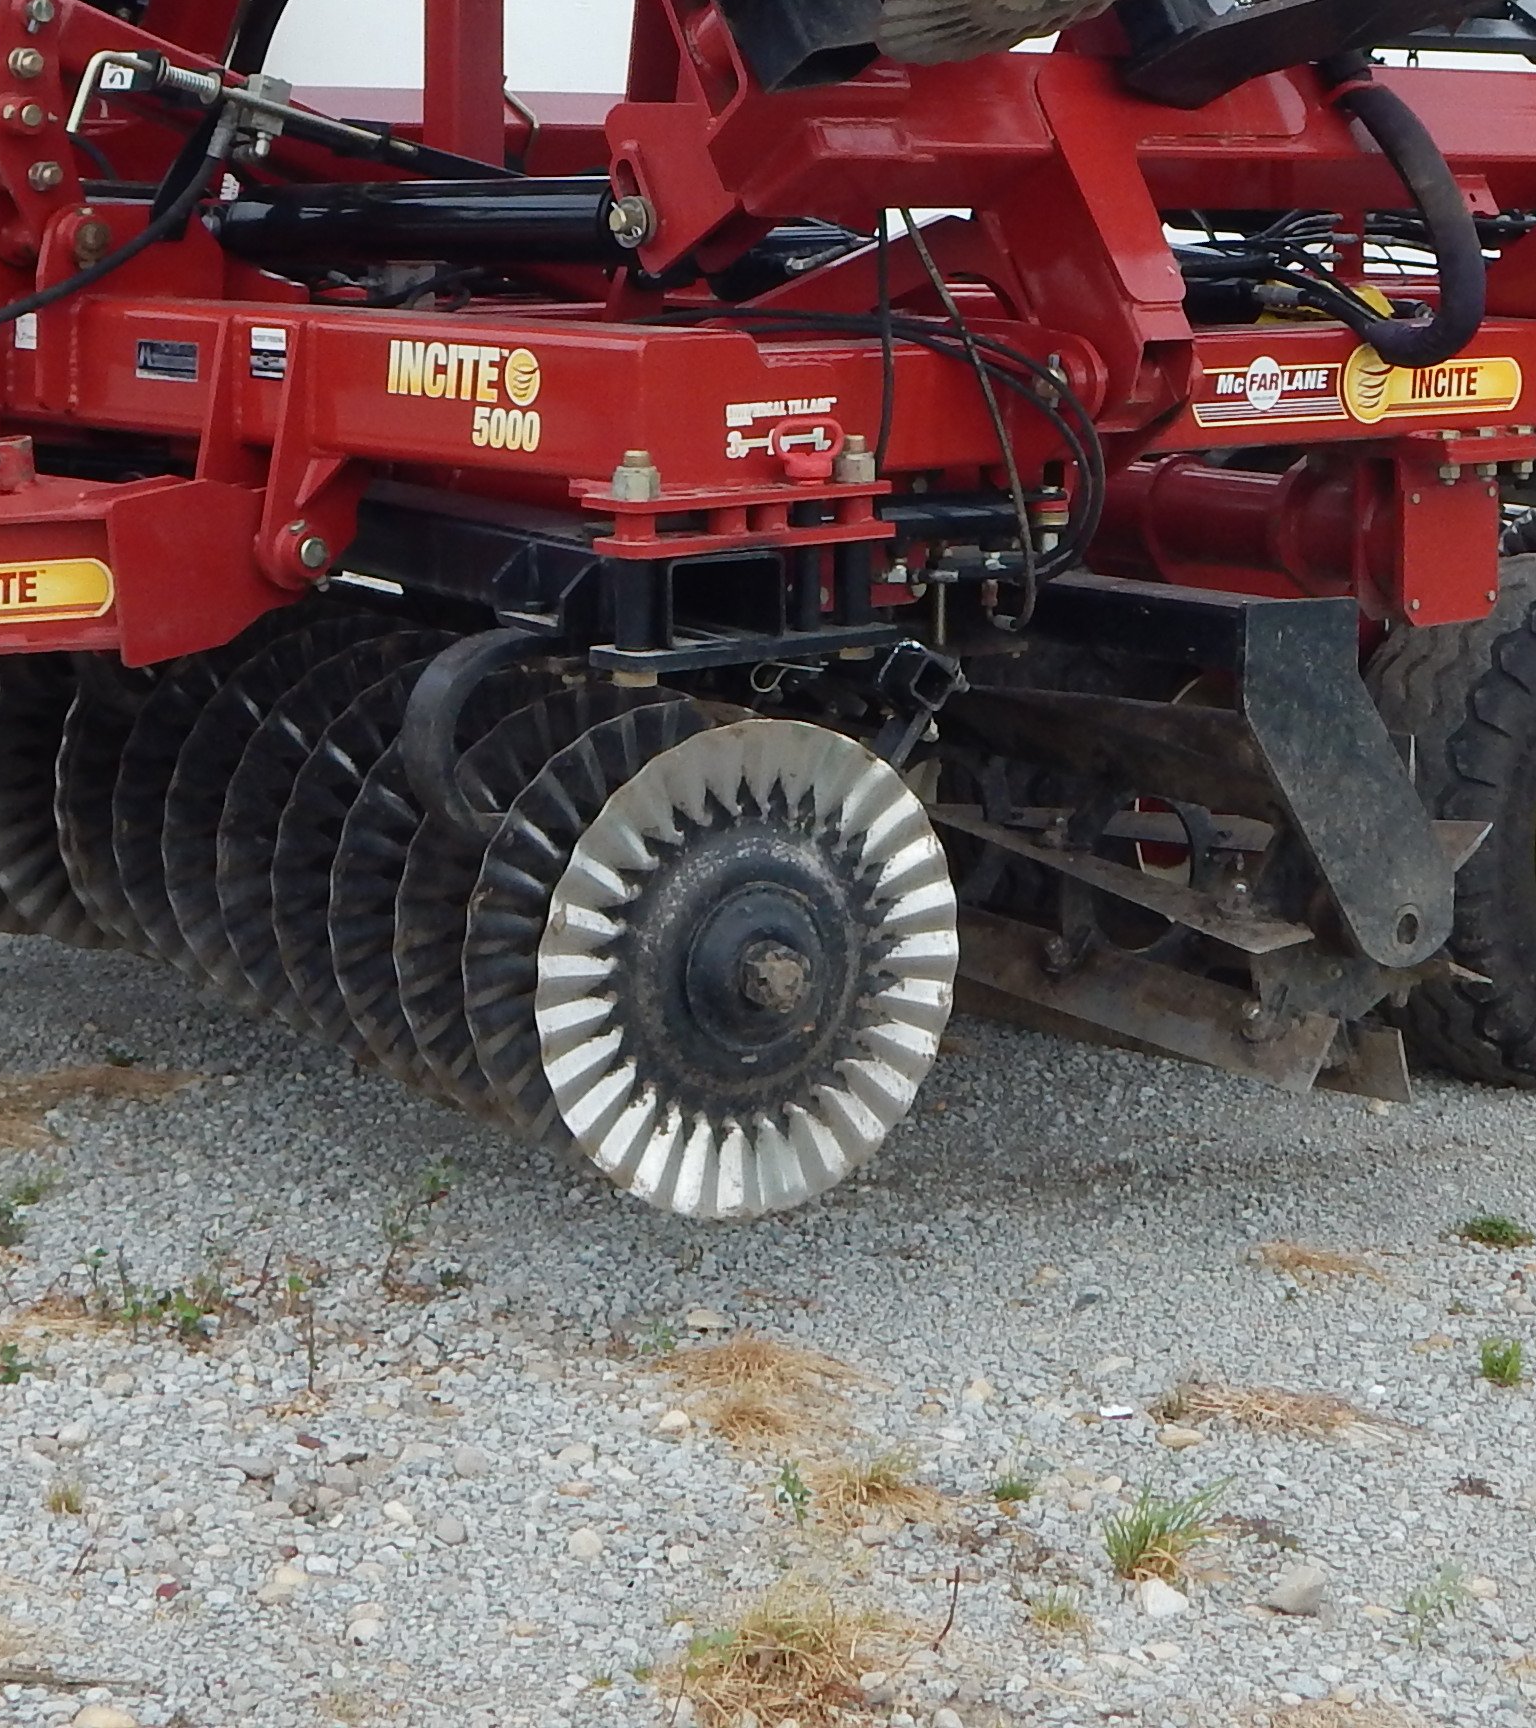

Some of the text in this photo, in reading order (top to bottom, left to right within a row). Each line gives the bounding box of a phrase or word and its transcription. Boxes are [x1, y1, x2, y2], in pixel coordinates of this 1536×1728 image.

[387, 339, 500, 403] INCITE
[1410, 366, 1480, 400] INCITE
[472, 406, 541, 452] 5000
